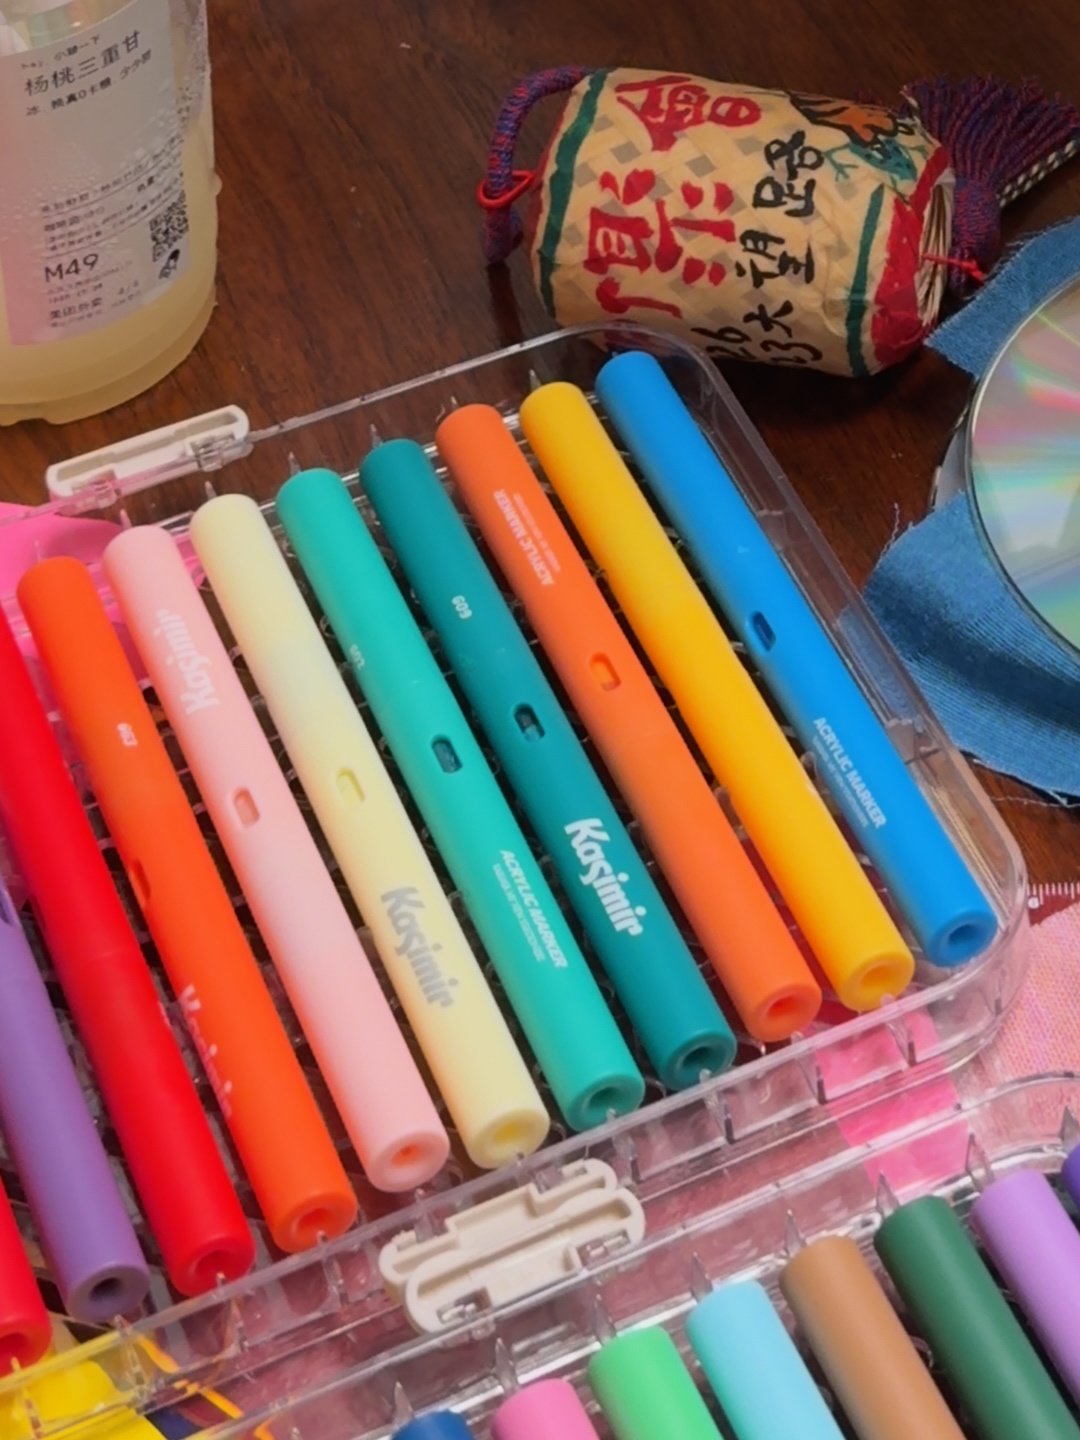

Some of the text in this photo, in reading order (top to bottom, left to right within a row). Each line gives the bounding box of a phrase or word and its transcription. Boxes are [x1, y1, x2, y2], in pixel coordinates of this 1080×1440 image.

[24, 30, 141, 96] 杨桃三重甘
[44, 253, 99, 283] M49
[493, 488, 528, 539] MARKER
[519, 536, 556, 587] ACRYLIC
[153, 608, 221, 714] Kasimir
[813, 717, 854, 773] ACRYLIC
[846, 769, 887, 829] MARKER
[500, 849, 540, 908] ACRYLIC
[528, 907, 568, 969] MARKER
[564, 817, 647, 936] Kasimir
[381, 887, 458, 1007] Kasimir
